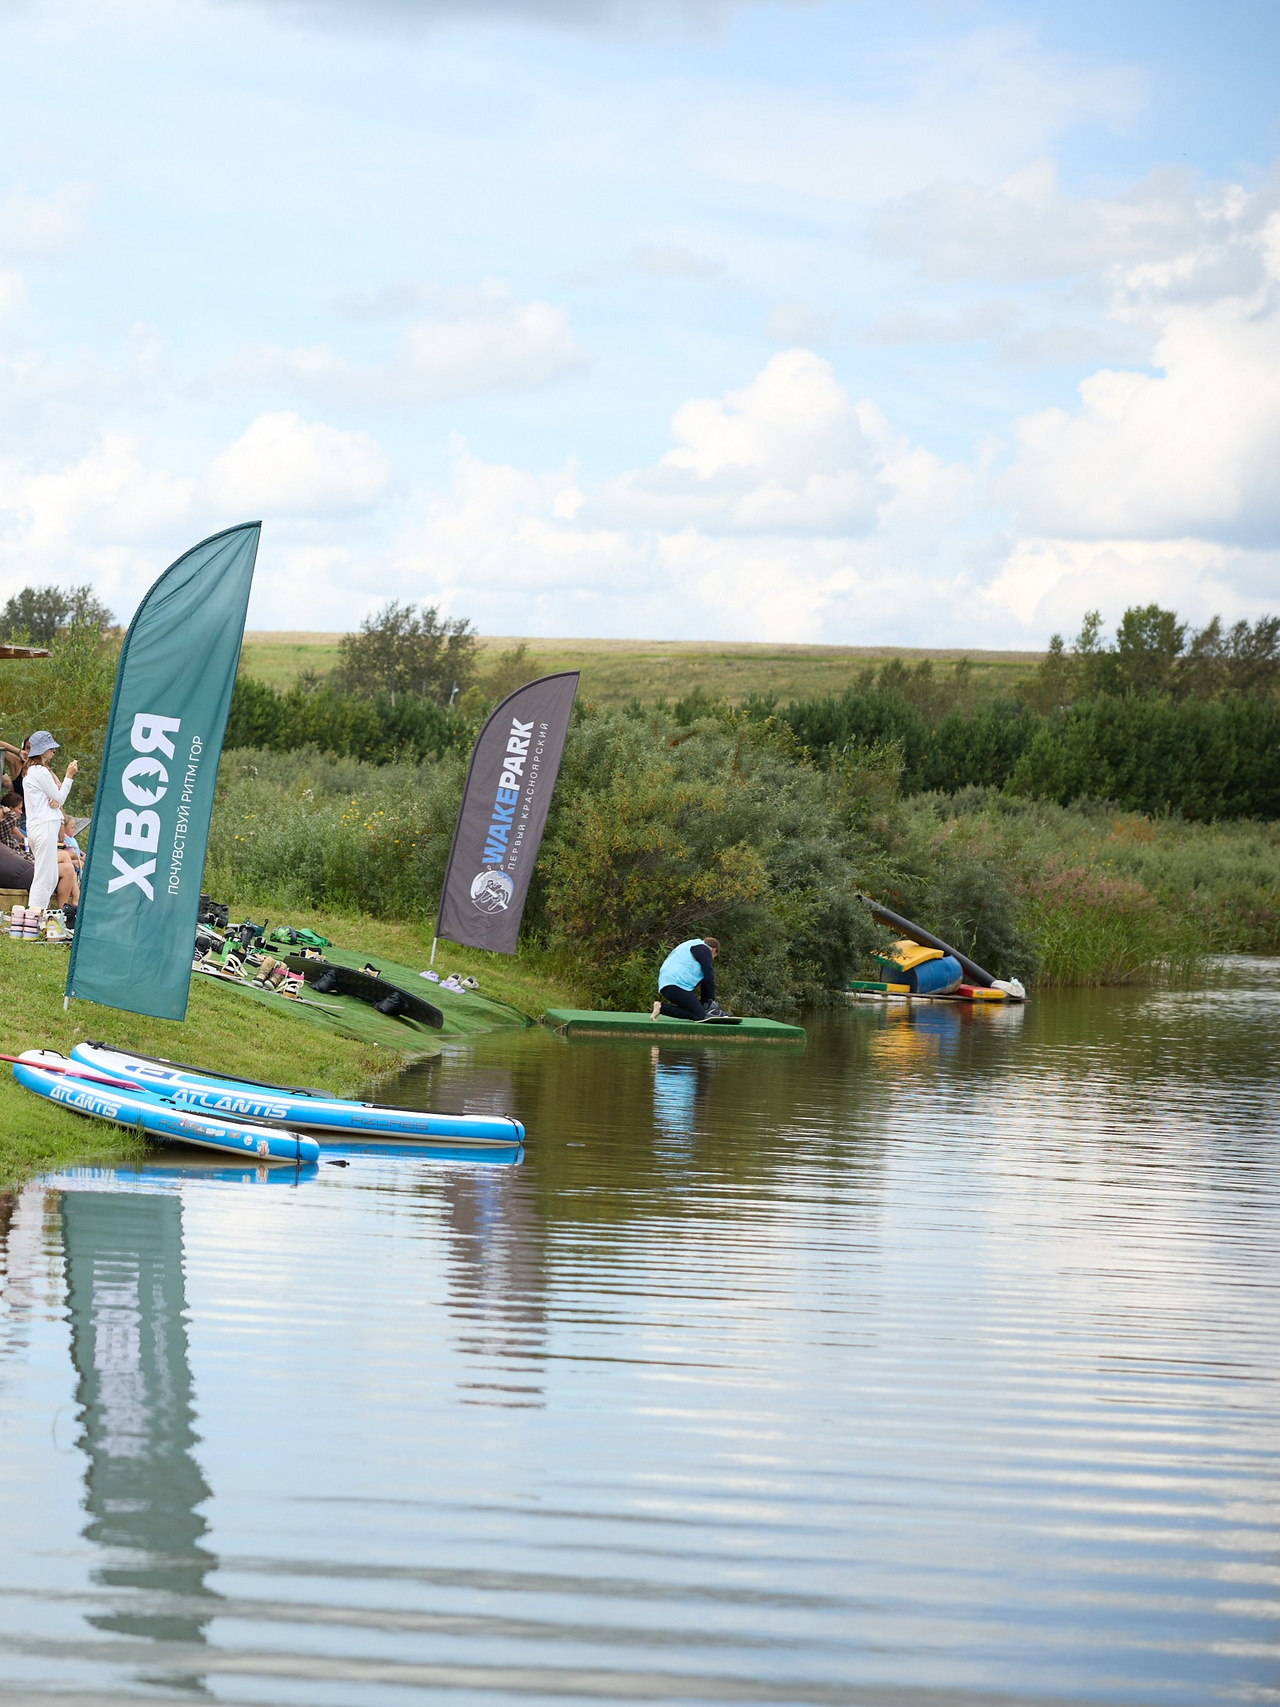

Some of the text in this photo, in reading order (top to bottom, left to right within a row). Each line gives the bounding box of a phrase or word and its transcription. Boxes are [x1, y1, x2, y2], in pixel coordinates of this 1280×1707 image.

[107, 713, 181, 902] ХВОЯ
[168, 735, 203, 895] ПОЧУВСТВУЙ РИТМ ГОР
[481, 717, 534, 864] WAKEPARK
[507, 723, 549, 870] ПЕРВЫЙ КРАСНОЯРСКИЙ
[49, 1084, 122, 1118] ATLANTIS
[171, 1088, 291, 1118] ATLANTIS
[351, 1116, 429, 1130] AZORES
